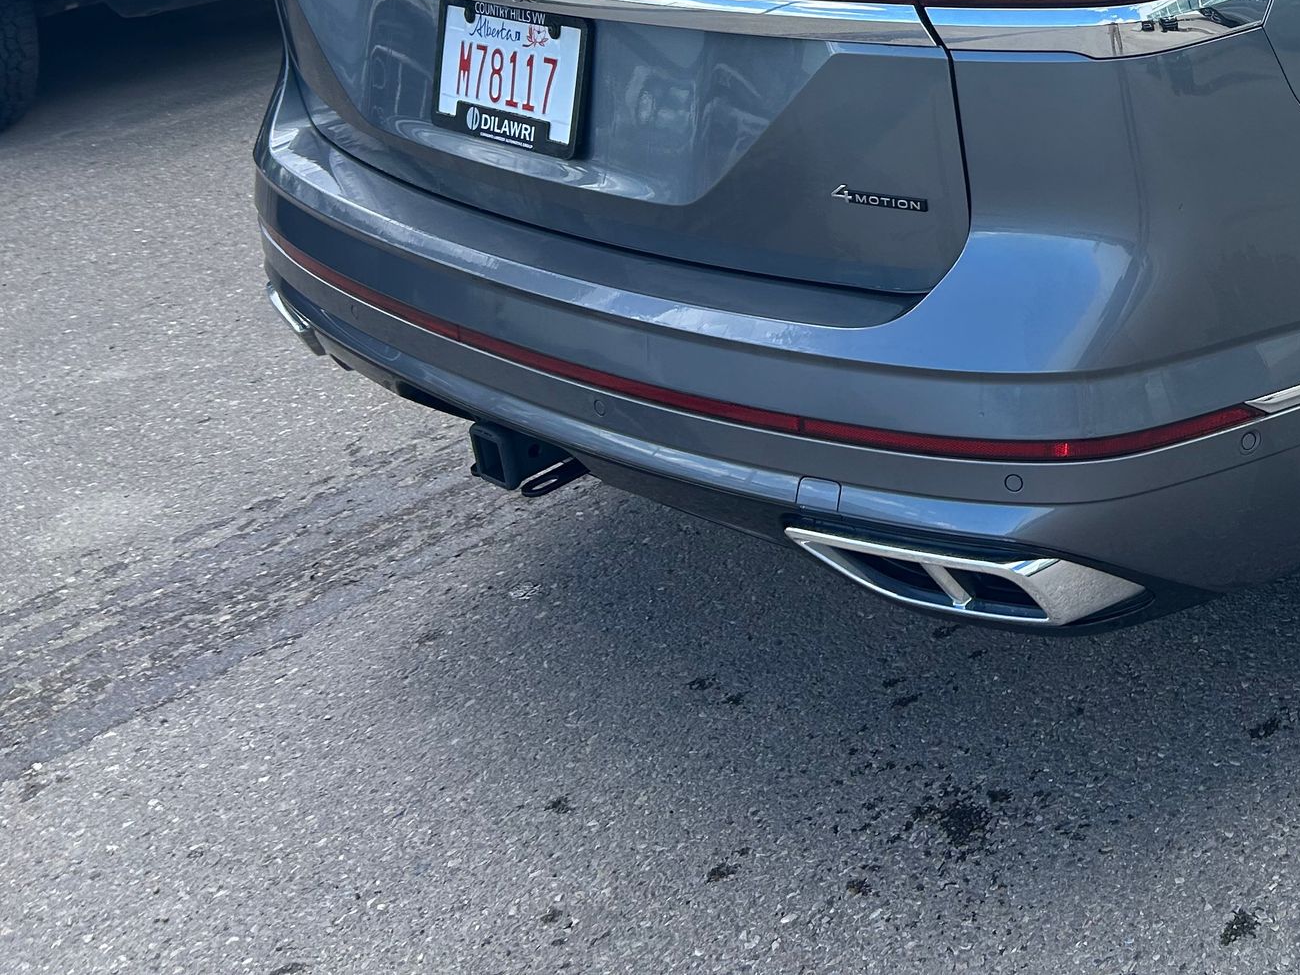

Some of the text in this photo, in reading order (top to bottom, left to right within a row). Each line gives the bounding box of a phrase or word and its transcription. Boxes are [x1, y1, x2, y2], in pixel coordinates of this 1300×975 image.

[474, 1, 546, 26] COUNTRY HILLS VW
[469, 14, 517, 42] Alberta
[456, 40, 558, 114] M78117
[480, 113, 536, 142] DILAWRI
